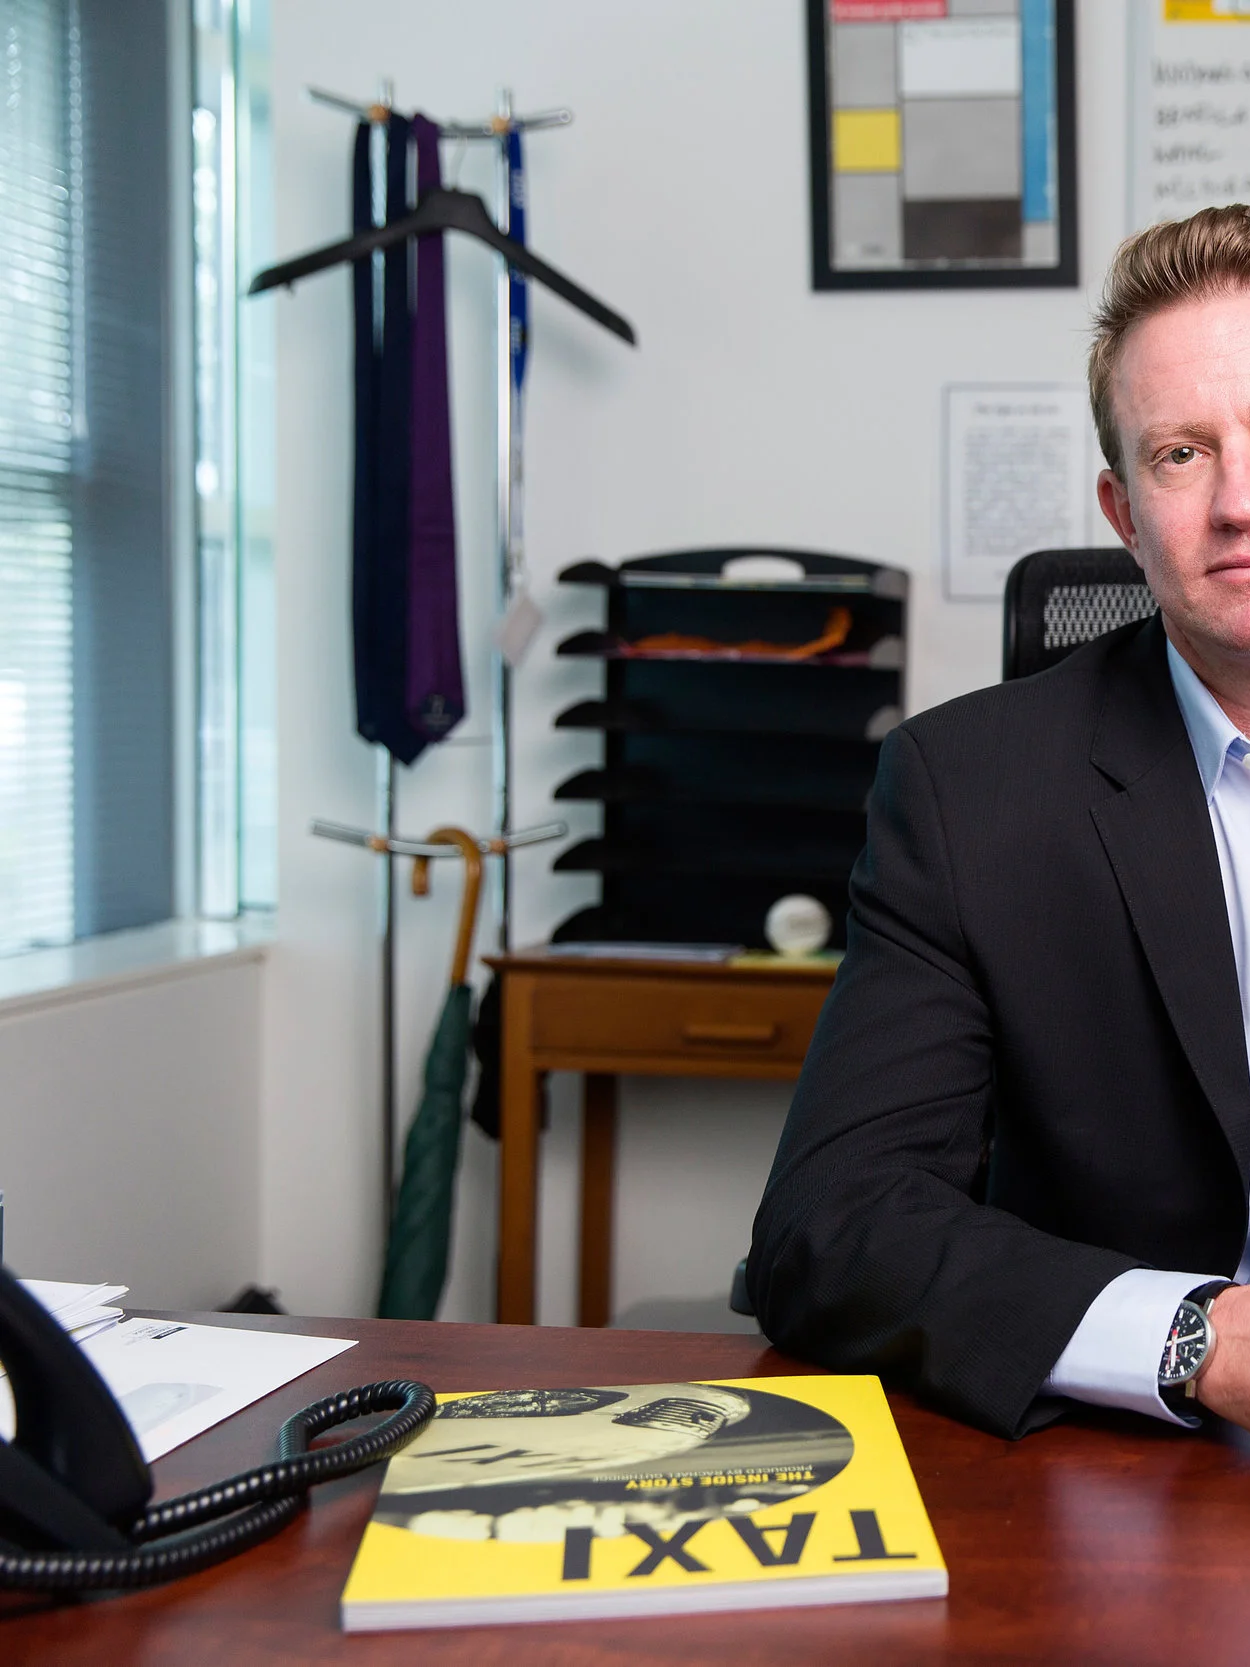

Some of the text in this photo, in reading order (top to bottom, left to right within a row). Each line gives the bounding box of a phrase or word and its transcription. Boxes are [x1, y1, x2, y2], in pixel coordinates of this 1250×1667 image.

[746, 1464, 813, 1474] PRODUCED
[625, 1470, 815, 1491] THE INSIDE STORY
[561, 1509, 917, 1580] TAXI
